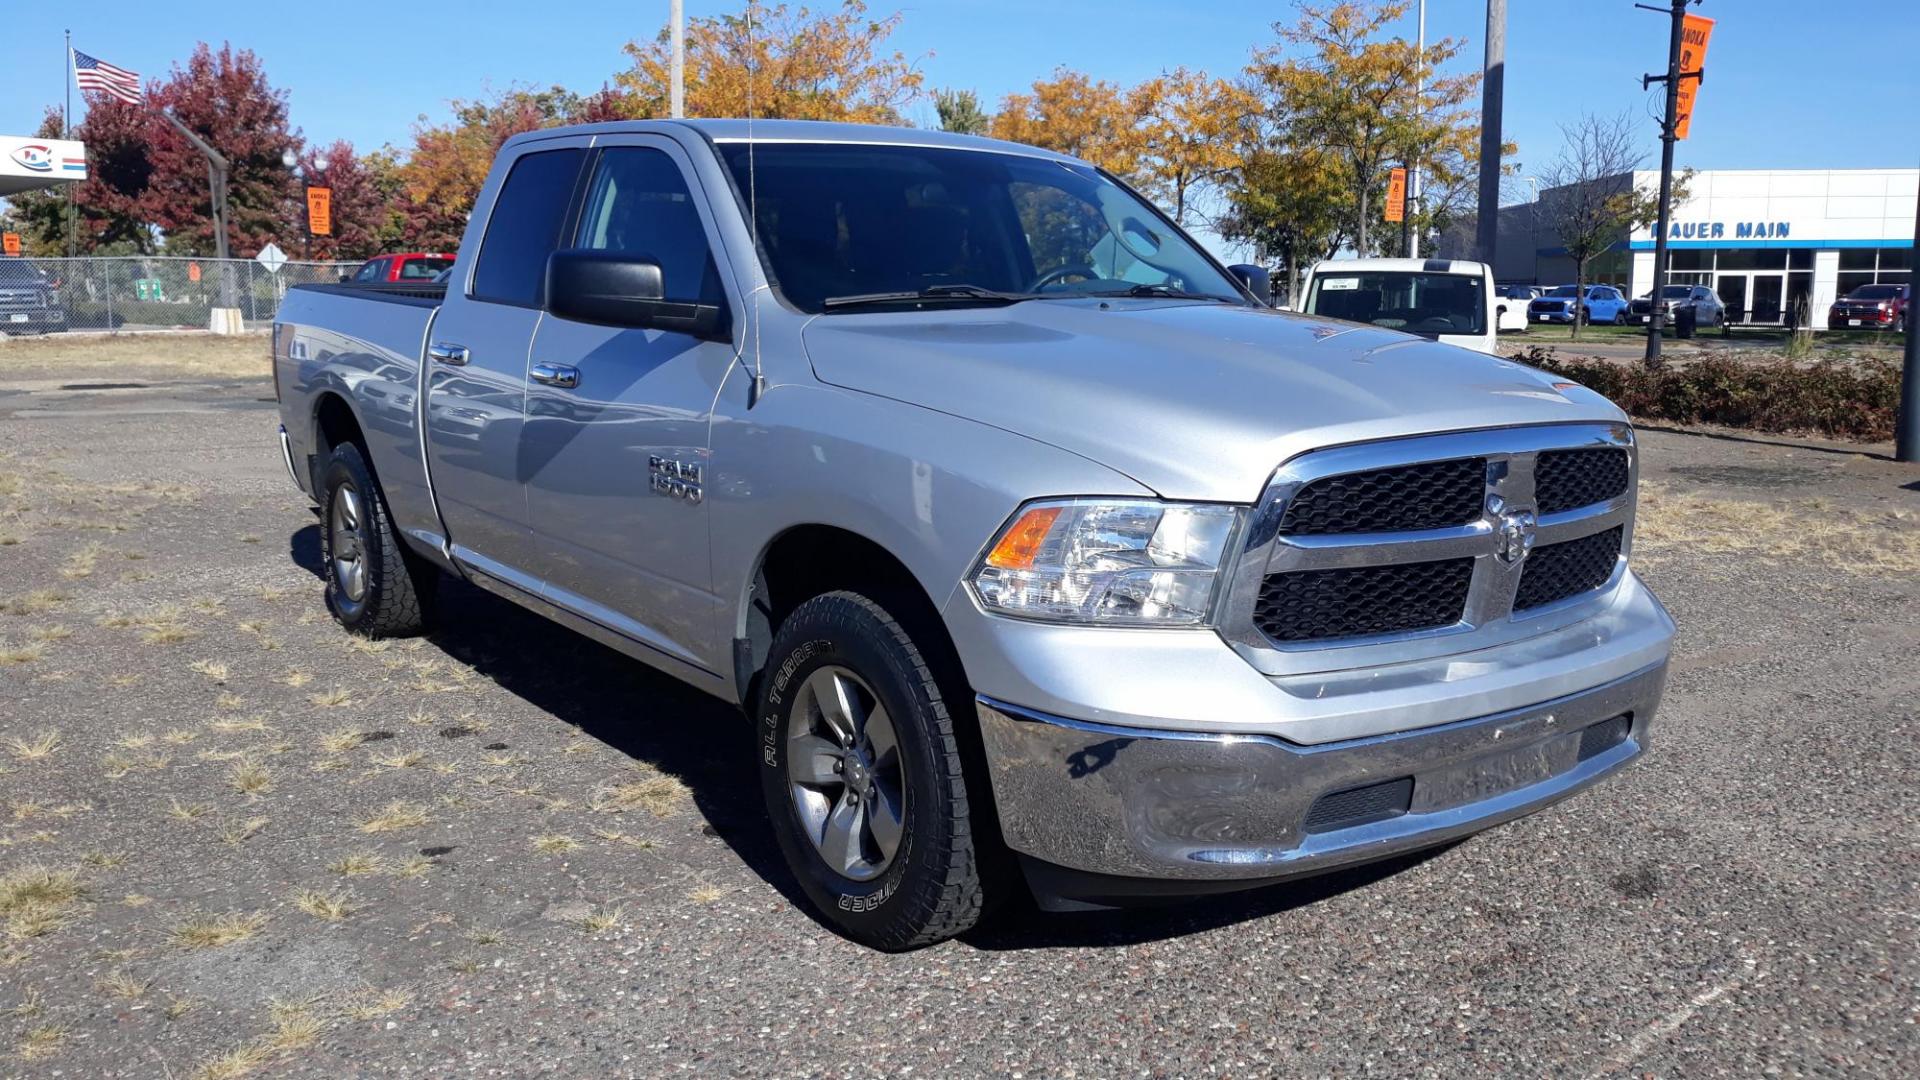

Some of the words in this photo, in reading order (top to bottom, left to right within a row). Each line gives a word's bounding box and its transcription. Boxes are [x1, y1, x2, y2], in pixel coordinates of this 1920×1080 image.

[1736, 222, 1790, 239] MAIN
[650, 454, 702, 485] RAM
[650, 472, 703, 504] 1500
[769, 639, 836, 705] TERRAIN
[764, 713, 778, 768] ALL
